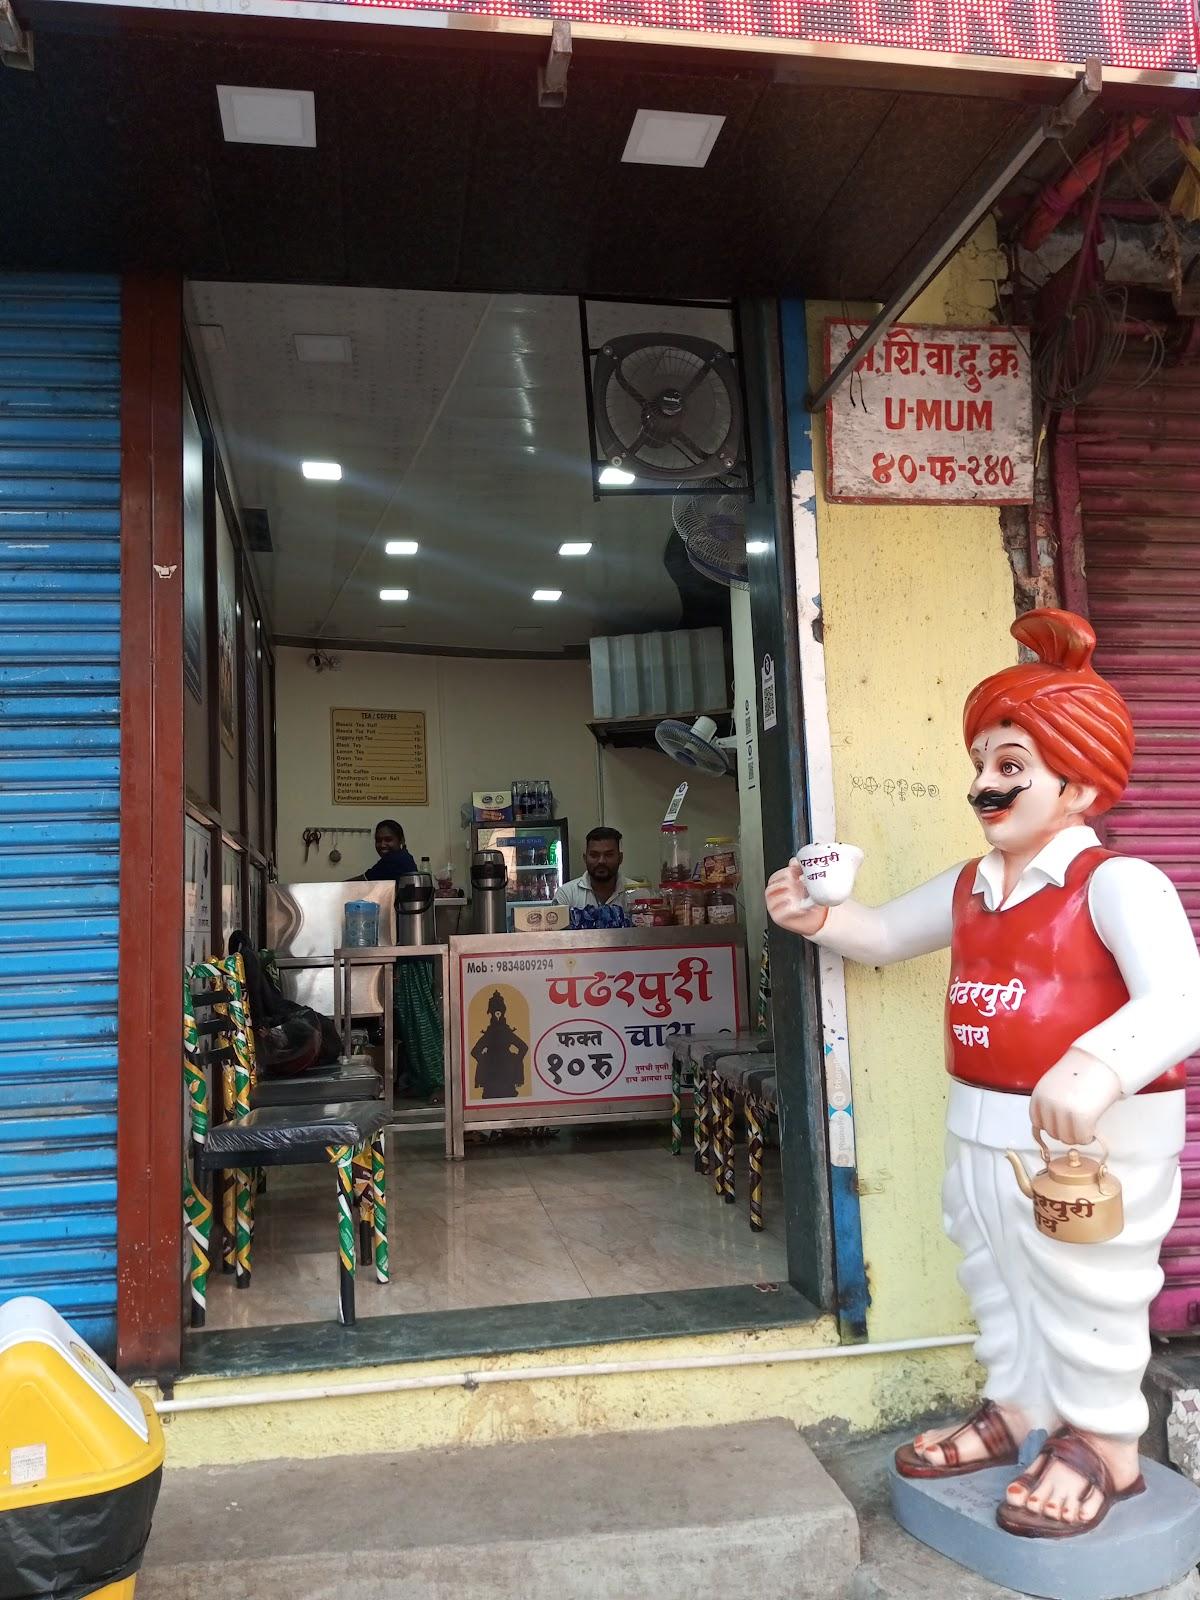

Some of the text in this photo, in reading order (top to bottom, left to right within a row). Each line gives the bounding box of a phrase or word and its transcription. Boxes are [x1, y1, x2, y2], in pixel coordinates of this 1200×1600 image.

[884, 397, 993, 432] U-MUM
[376, 713, 398, 721] COFFEE
[467, 961, 488, 974] Mob
[496, 958, 554, 973] 9834809294
[556, 1030, 603, 1048] फक्त
[952, 1024, 990, 1049] चाय
